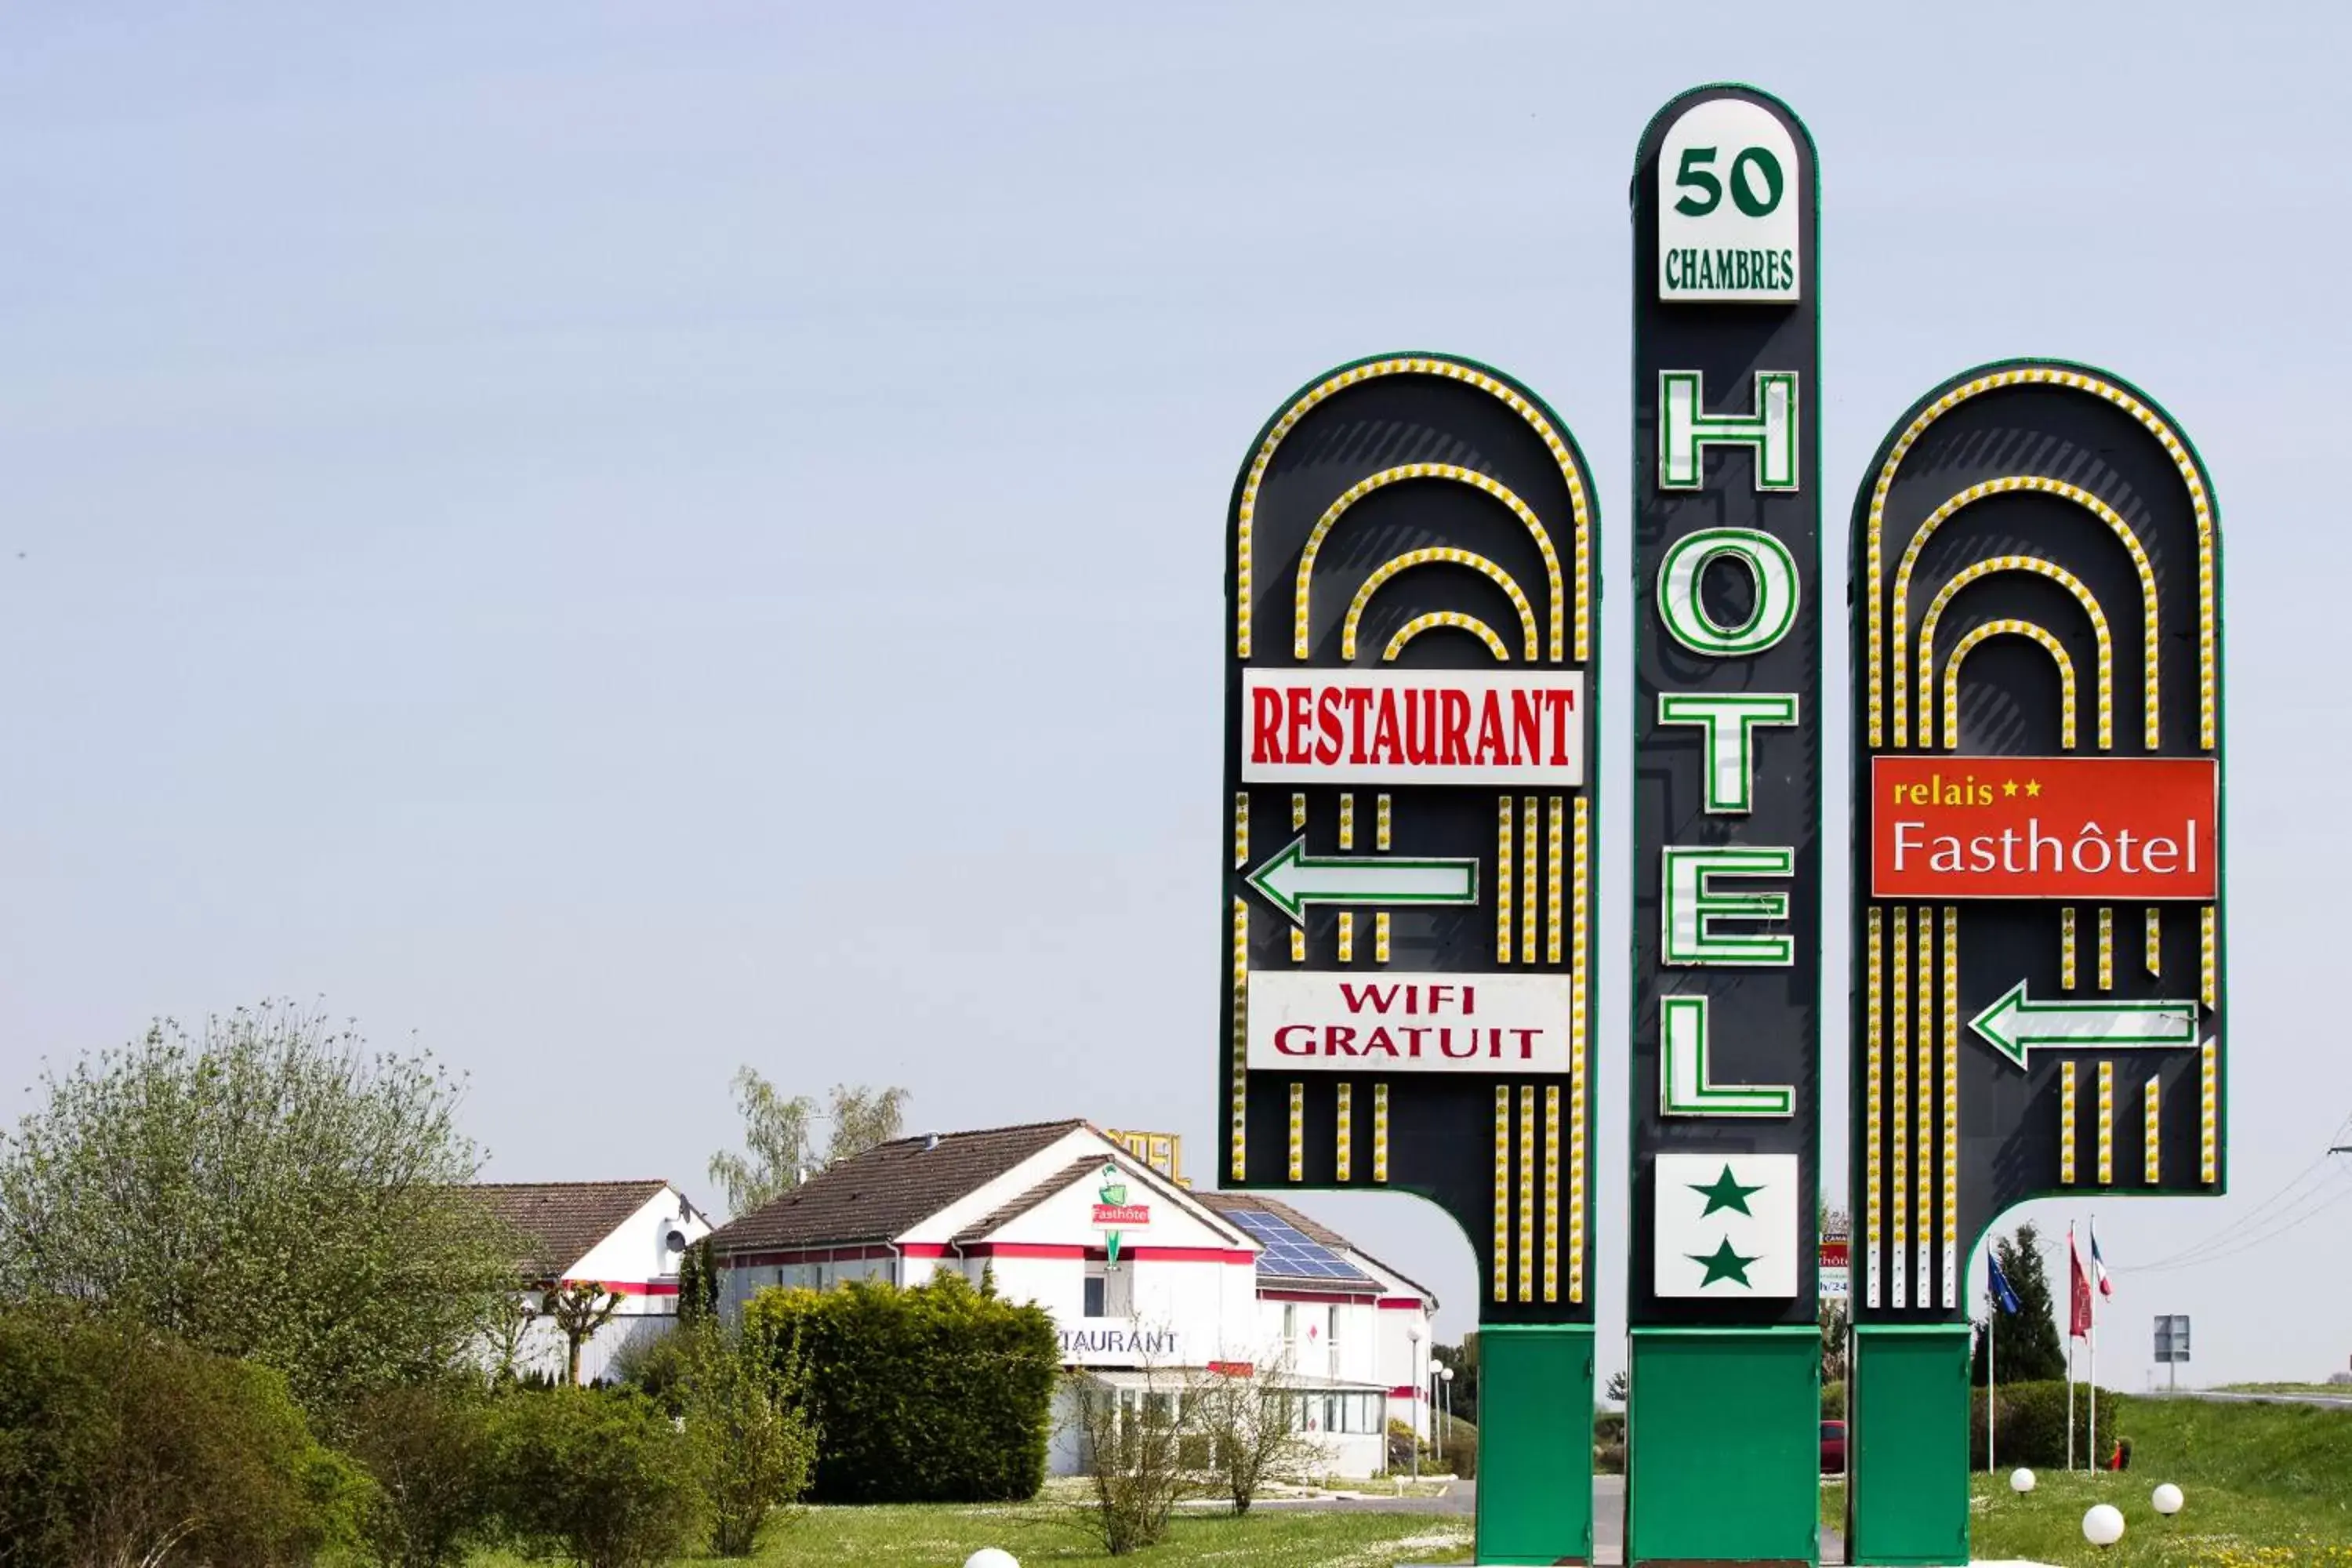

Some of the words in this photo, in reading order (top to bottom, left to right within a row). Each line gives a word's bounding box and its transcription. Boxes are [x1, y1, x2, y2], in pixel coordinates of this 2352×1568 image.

[1674, 146, 1784, 217] 50
[1665, 248, 1794, 290] CHAMBRES
[1250, 686, 1574, 766] RESTAURANT
[1656, 369, 1801, 1117] HOTEL
[1893, 774, 1994, 806] relais
[1893, 818, 2197, 873] Fasthôtel
[1339, 983, 1475, 1014] WIFI
[1274, 1025, 1544, 1059] GRATUIT
